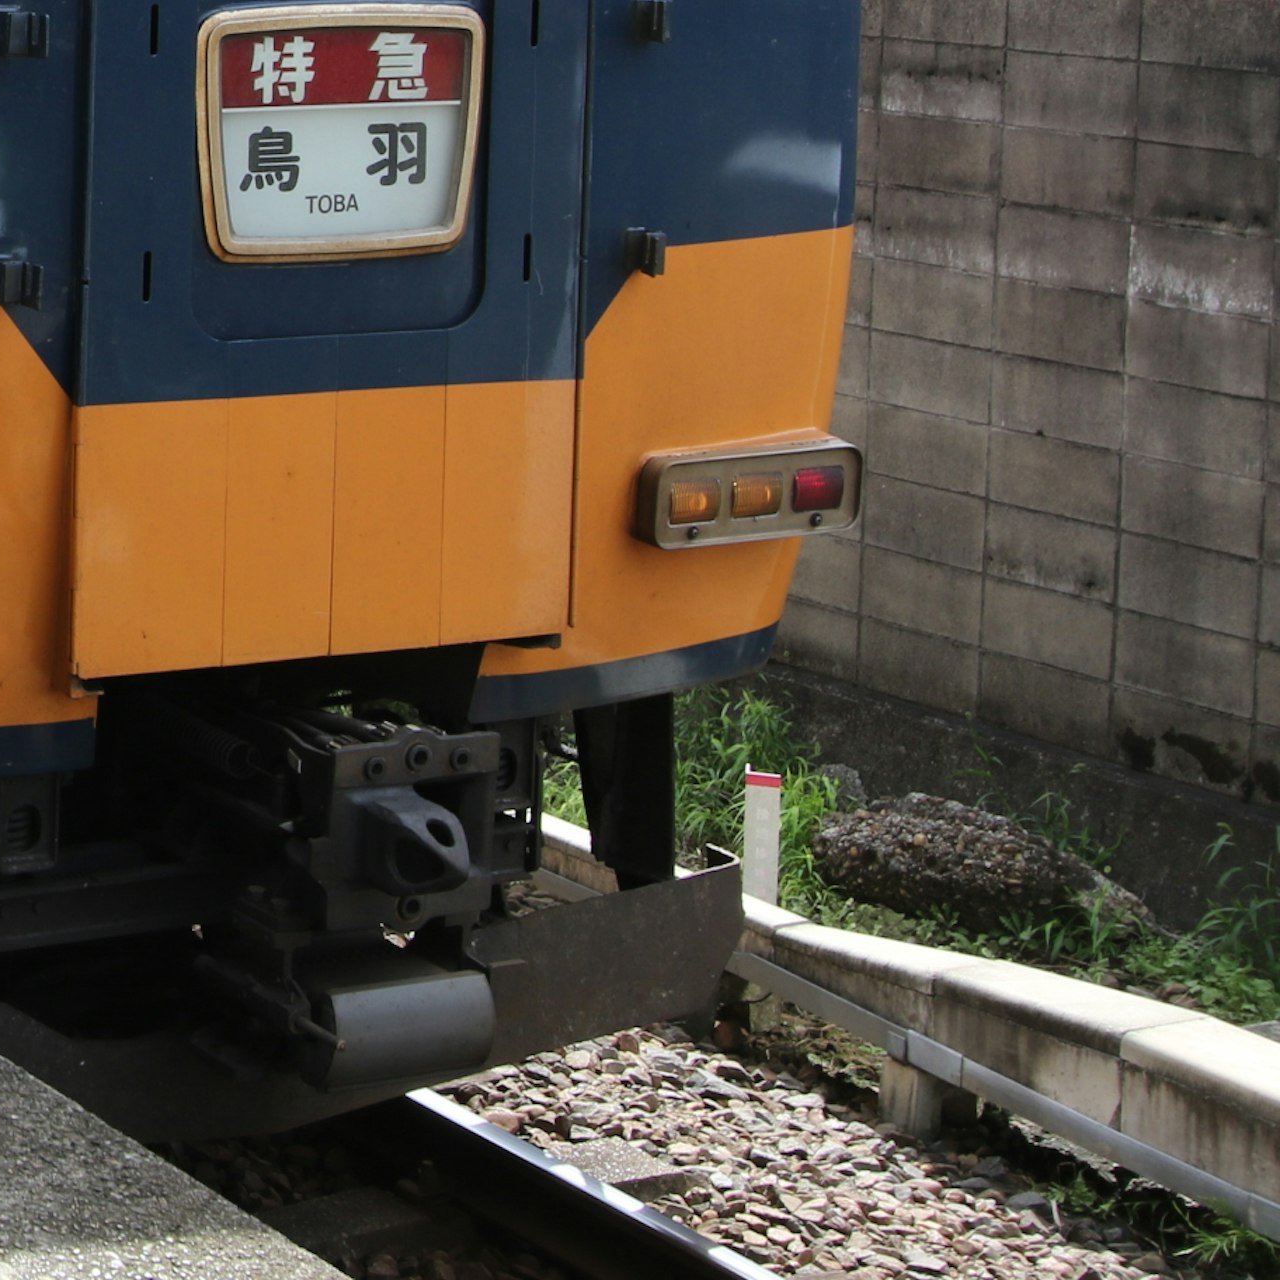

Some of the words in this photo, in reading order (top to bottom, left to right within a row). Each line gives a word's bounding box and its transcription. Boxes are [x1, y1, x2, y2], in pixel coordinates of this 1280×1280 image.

[250, 32, 429, 104] 特急
[239, 122, 427, 192] 鳥羽
[305, 193, 359, 214] TOBA
